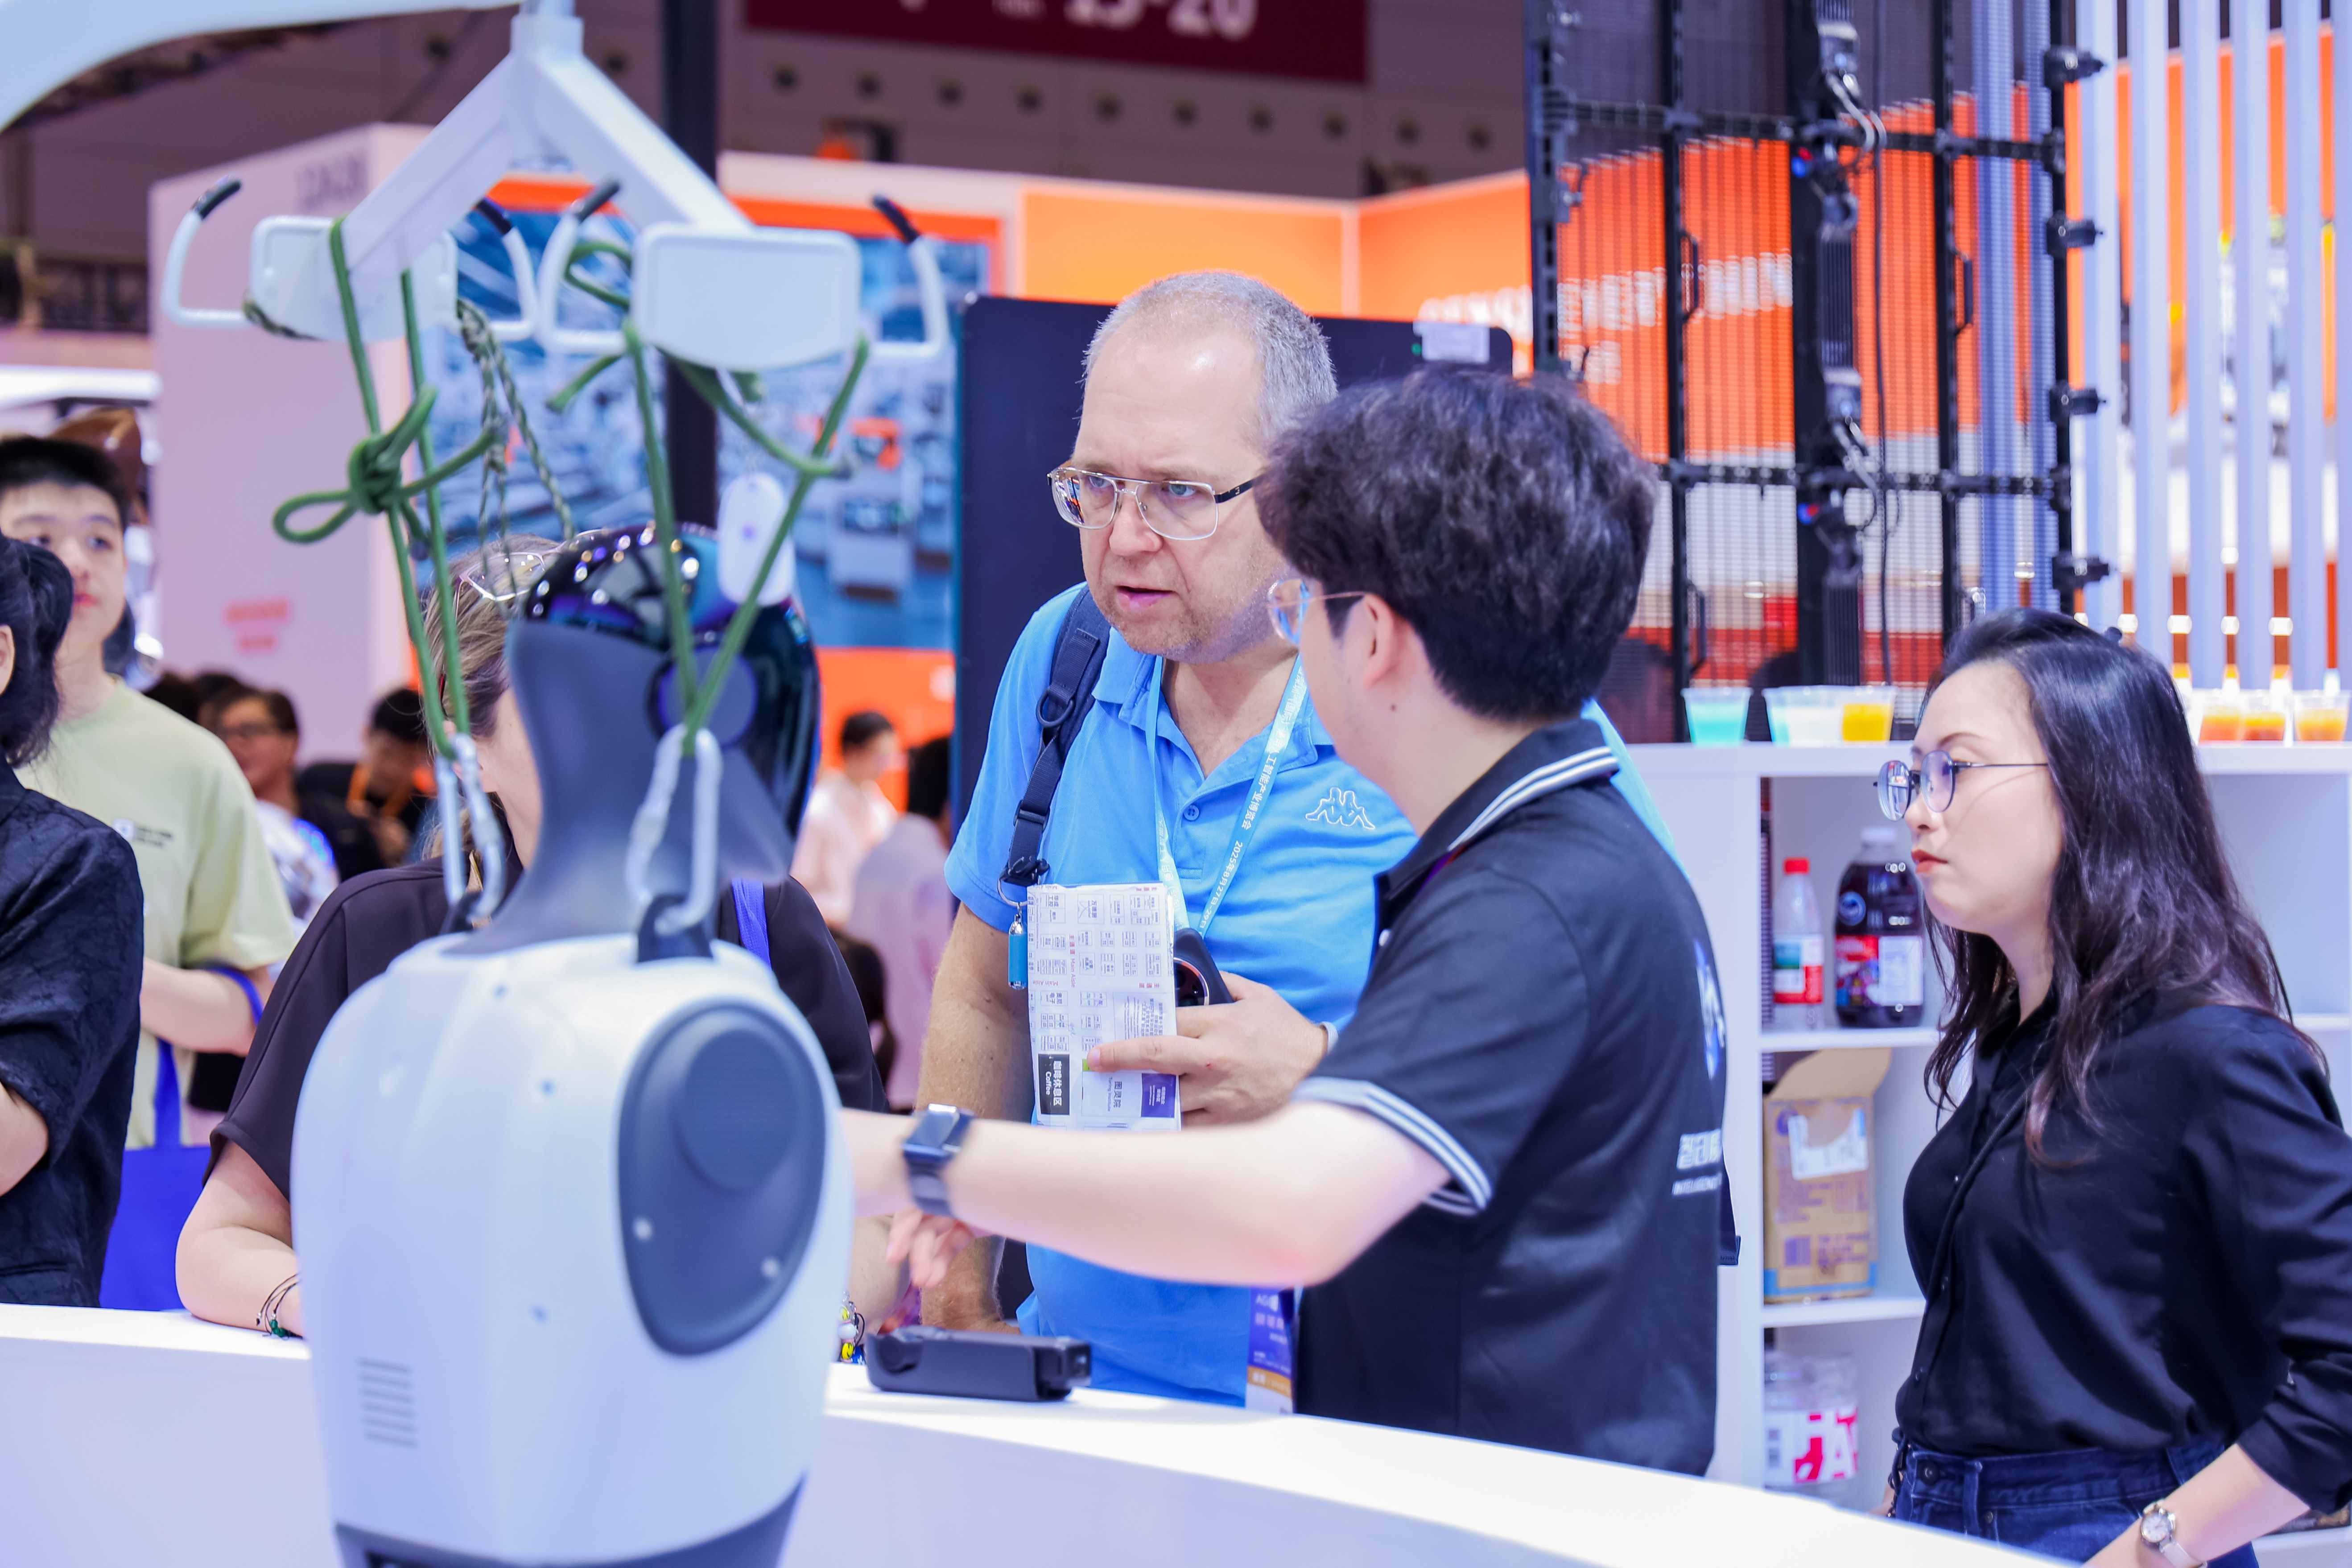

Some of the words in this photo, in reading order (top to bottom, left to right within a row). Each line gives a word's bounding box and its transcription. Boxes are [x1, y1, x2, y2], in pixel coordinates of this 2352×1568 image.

[1053, 1060, 1062, 1106] 咖啡休息区
